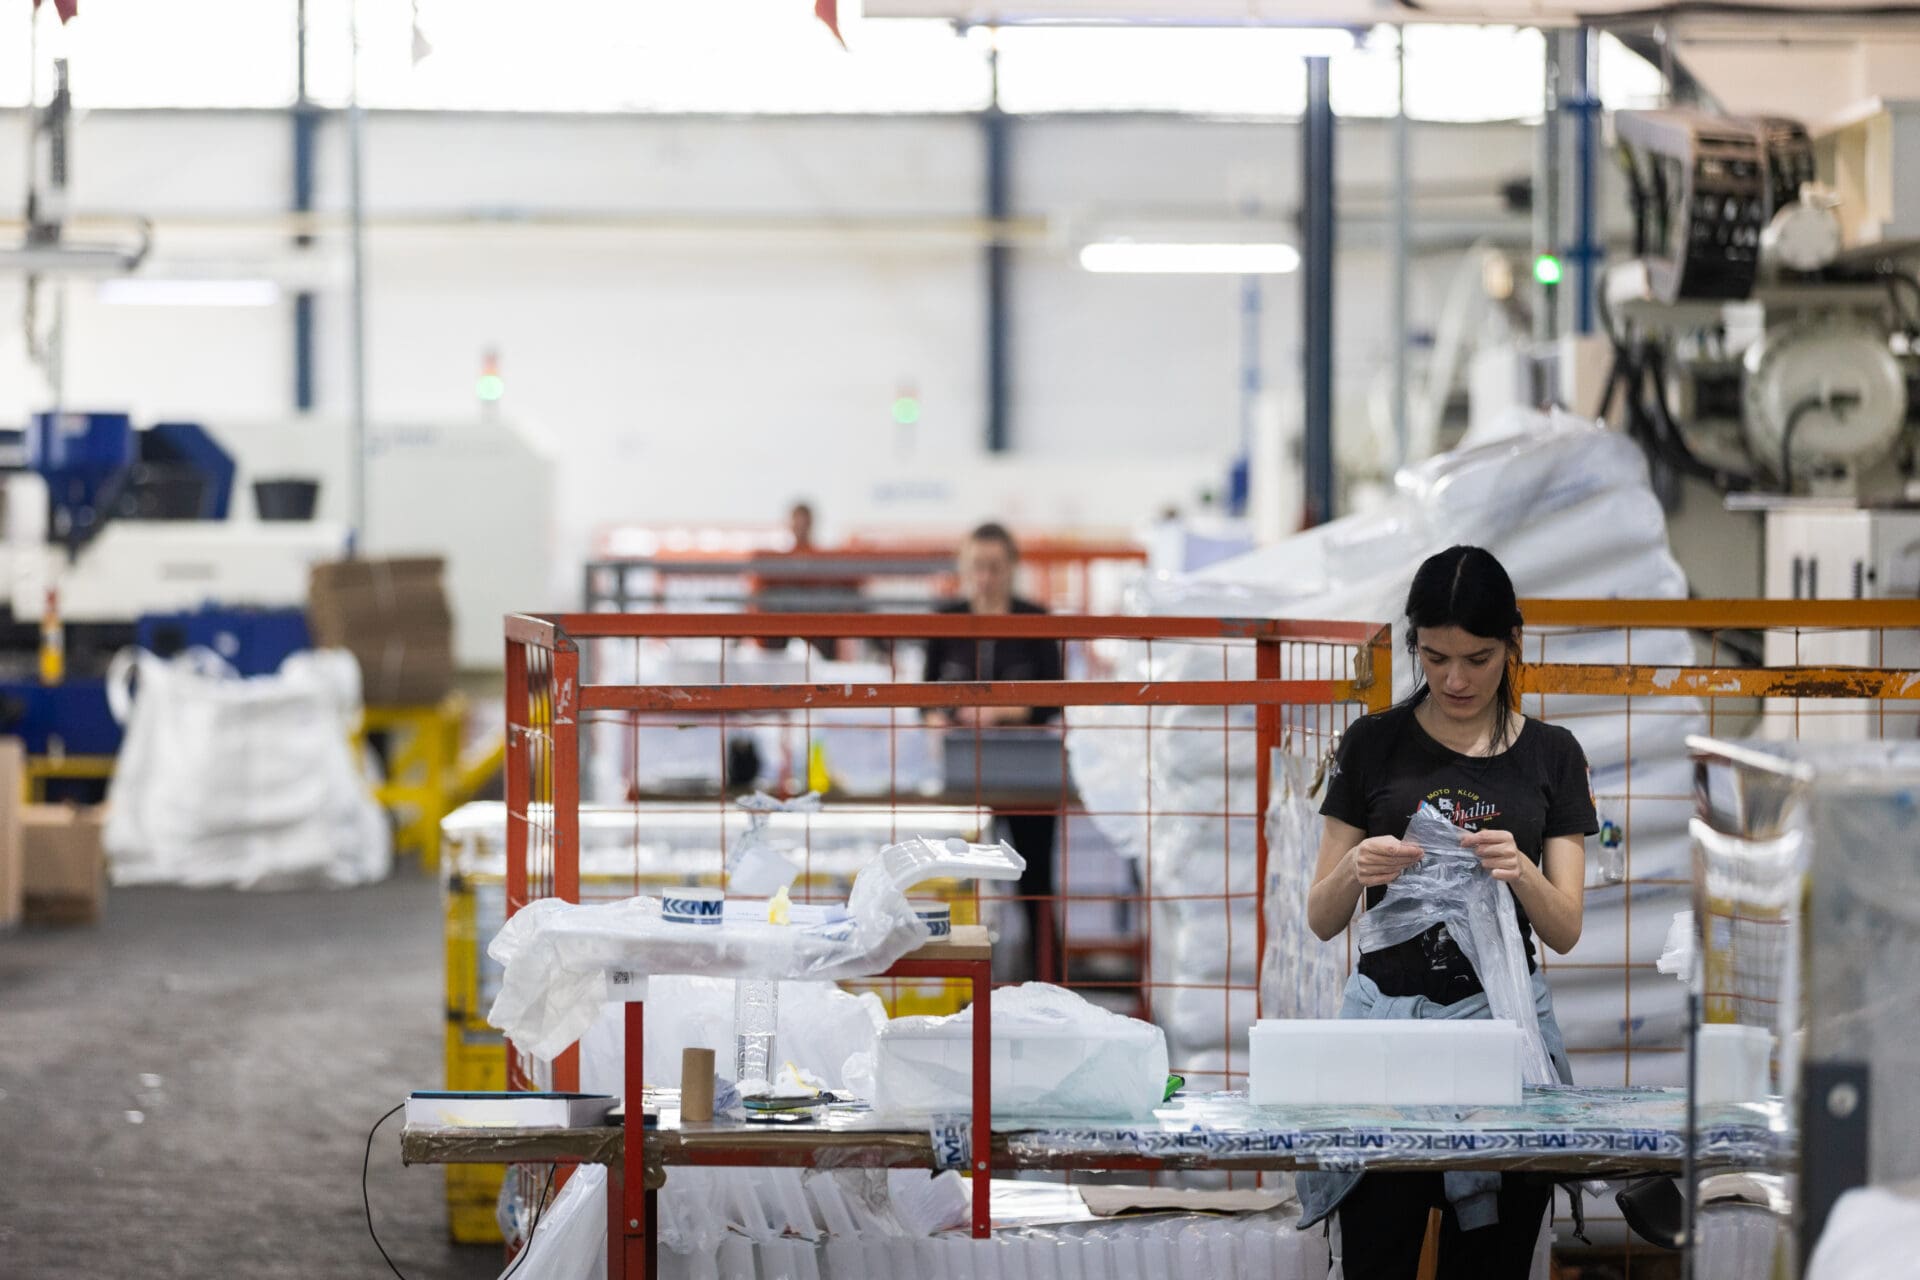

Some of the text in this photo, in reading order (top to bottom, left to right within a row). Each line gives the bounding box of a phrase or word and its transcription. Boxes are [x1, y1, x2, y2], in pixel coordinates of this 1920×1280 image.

[1427, 788, 1480, 801] MOTO KLUB
[1328, 1134, 1383, 1148] MPK
[1418, 1134, 1475, 1149] MPK
[1510, 1134, 1566, 1148] MPK
[1602, 1135, 1657, 1150] MPK
